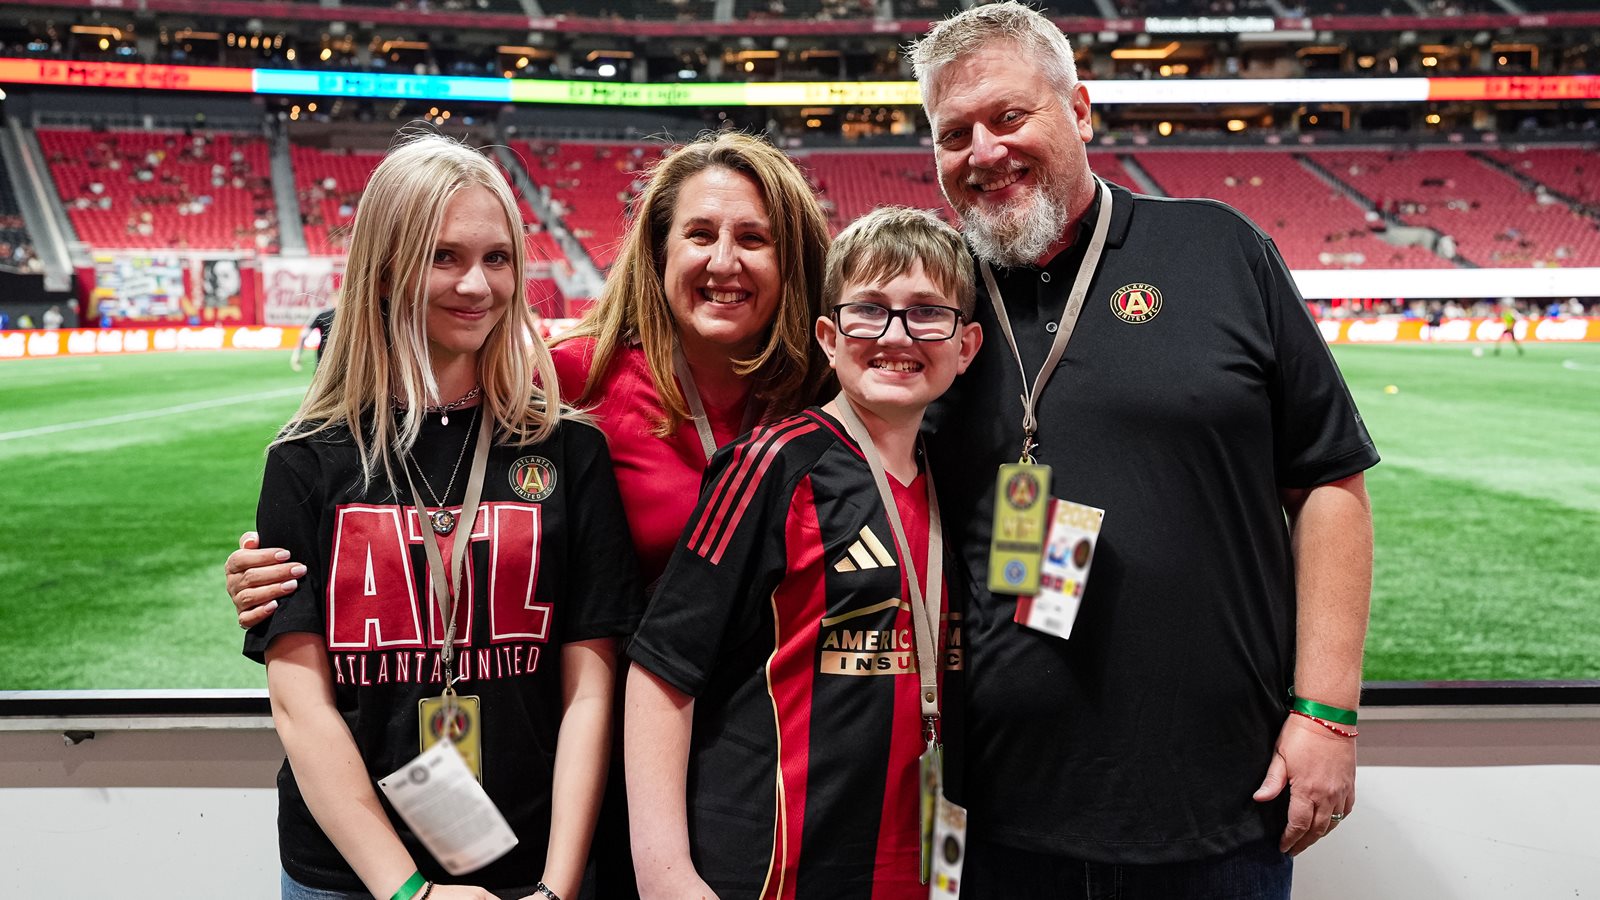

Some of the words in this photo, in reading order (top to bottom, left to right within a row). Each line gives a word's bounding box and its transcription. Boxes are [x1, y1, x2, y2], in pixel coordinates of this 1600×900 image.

[1118, 284, 1153, 295] ATLANTA
[1117, 310, 1147, 322] UNITED
[1147, 307, 1158, 317] FC
[1124, 292, 1150, 315] A
[516, 457, 551, 468] ATLANTA
[522, 467, 545, 492] A
[515, 485, 541, 500] UNITED
[543, 486, 552, 496] FC
[326, 501, 554, 651] ATL
[822, 628, 913, 651] AMERIC
[334, 651, 442, 686] ATLANTA
[459, 646, 540, 681] UNITED
